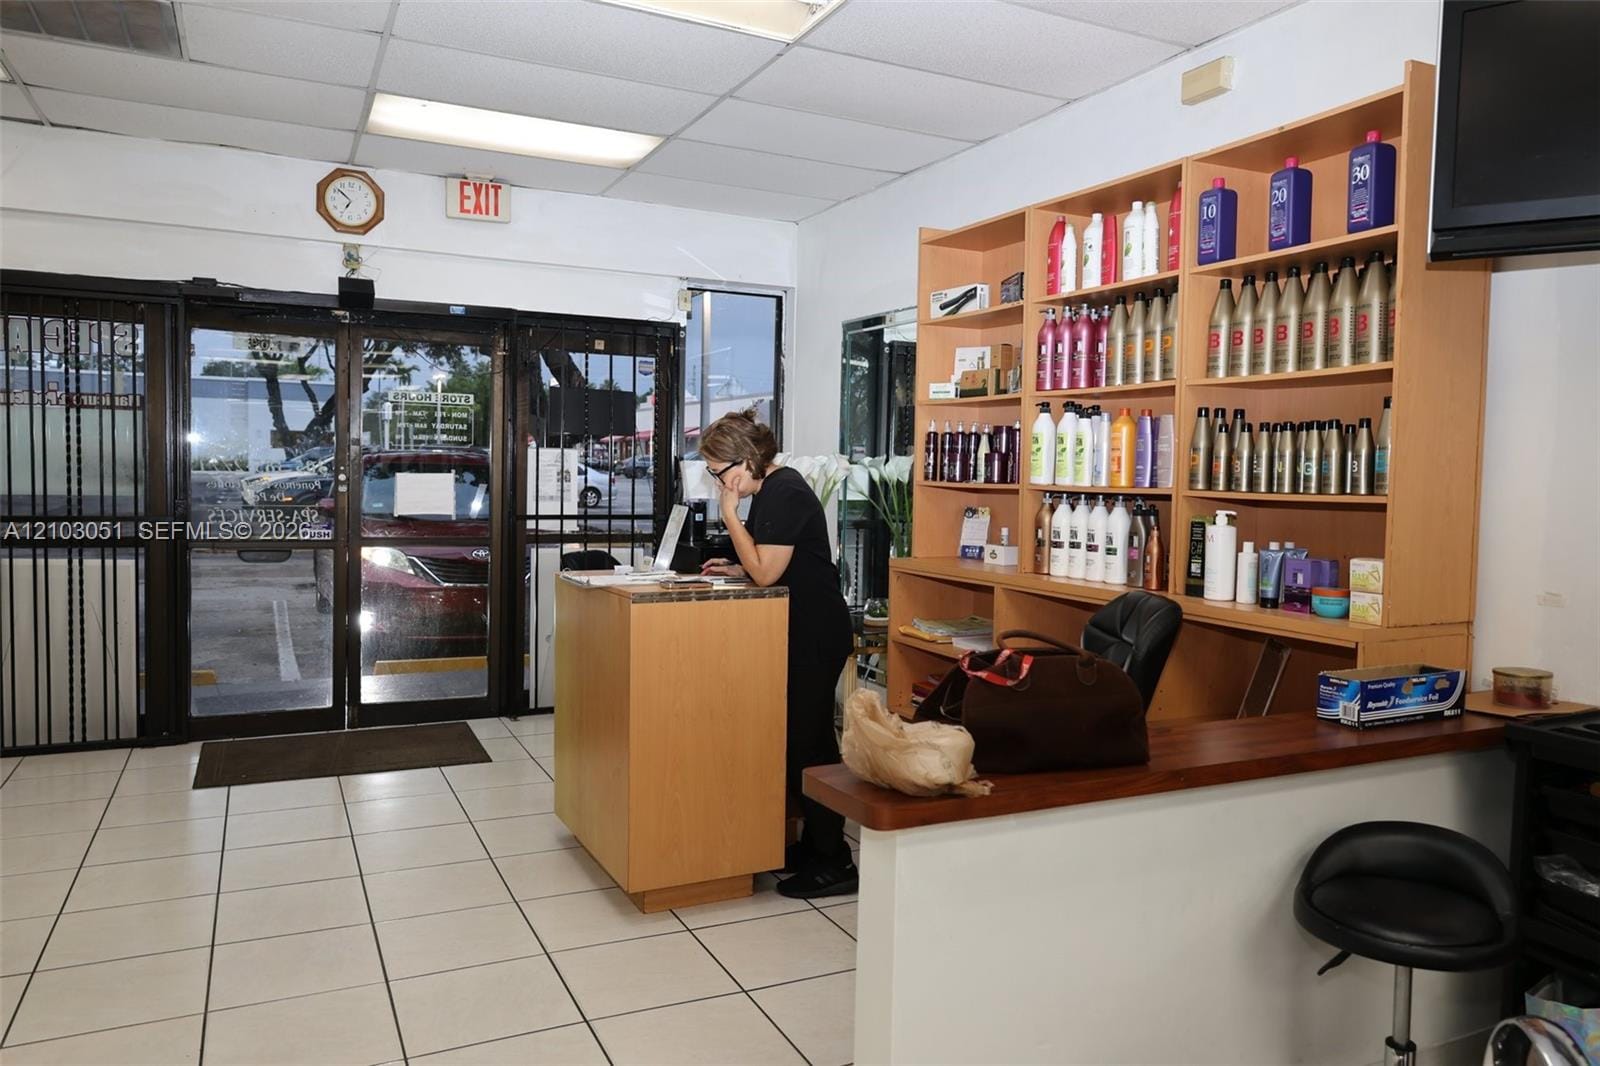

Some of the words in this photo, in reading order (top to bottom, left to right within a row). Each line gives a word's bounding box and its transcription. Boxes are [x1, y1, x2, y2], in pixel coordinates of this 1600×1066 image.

[1351, 163, 1370, 185] 30
[459, 180, 502, 217] EXIT
[1271, 187, 1288, 206] 20
[1202, 204, 1217, 220] 10
[1232, 330, 1244, 346] B
[1253, 328, 1264, 345] B
[1276, 324, 1288, 341] B
[1302, 321, 1314, 339] B
[1209, 332, 1220, 349] B
